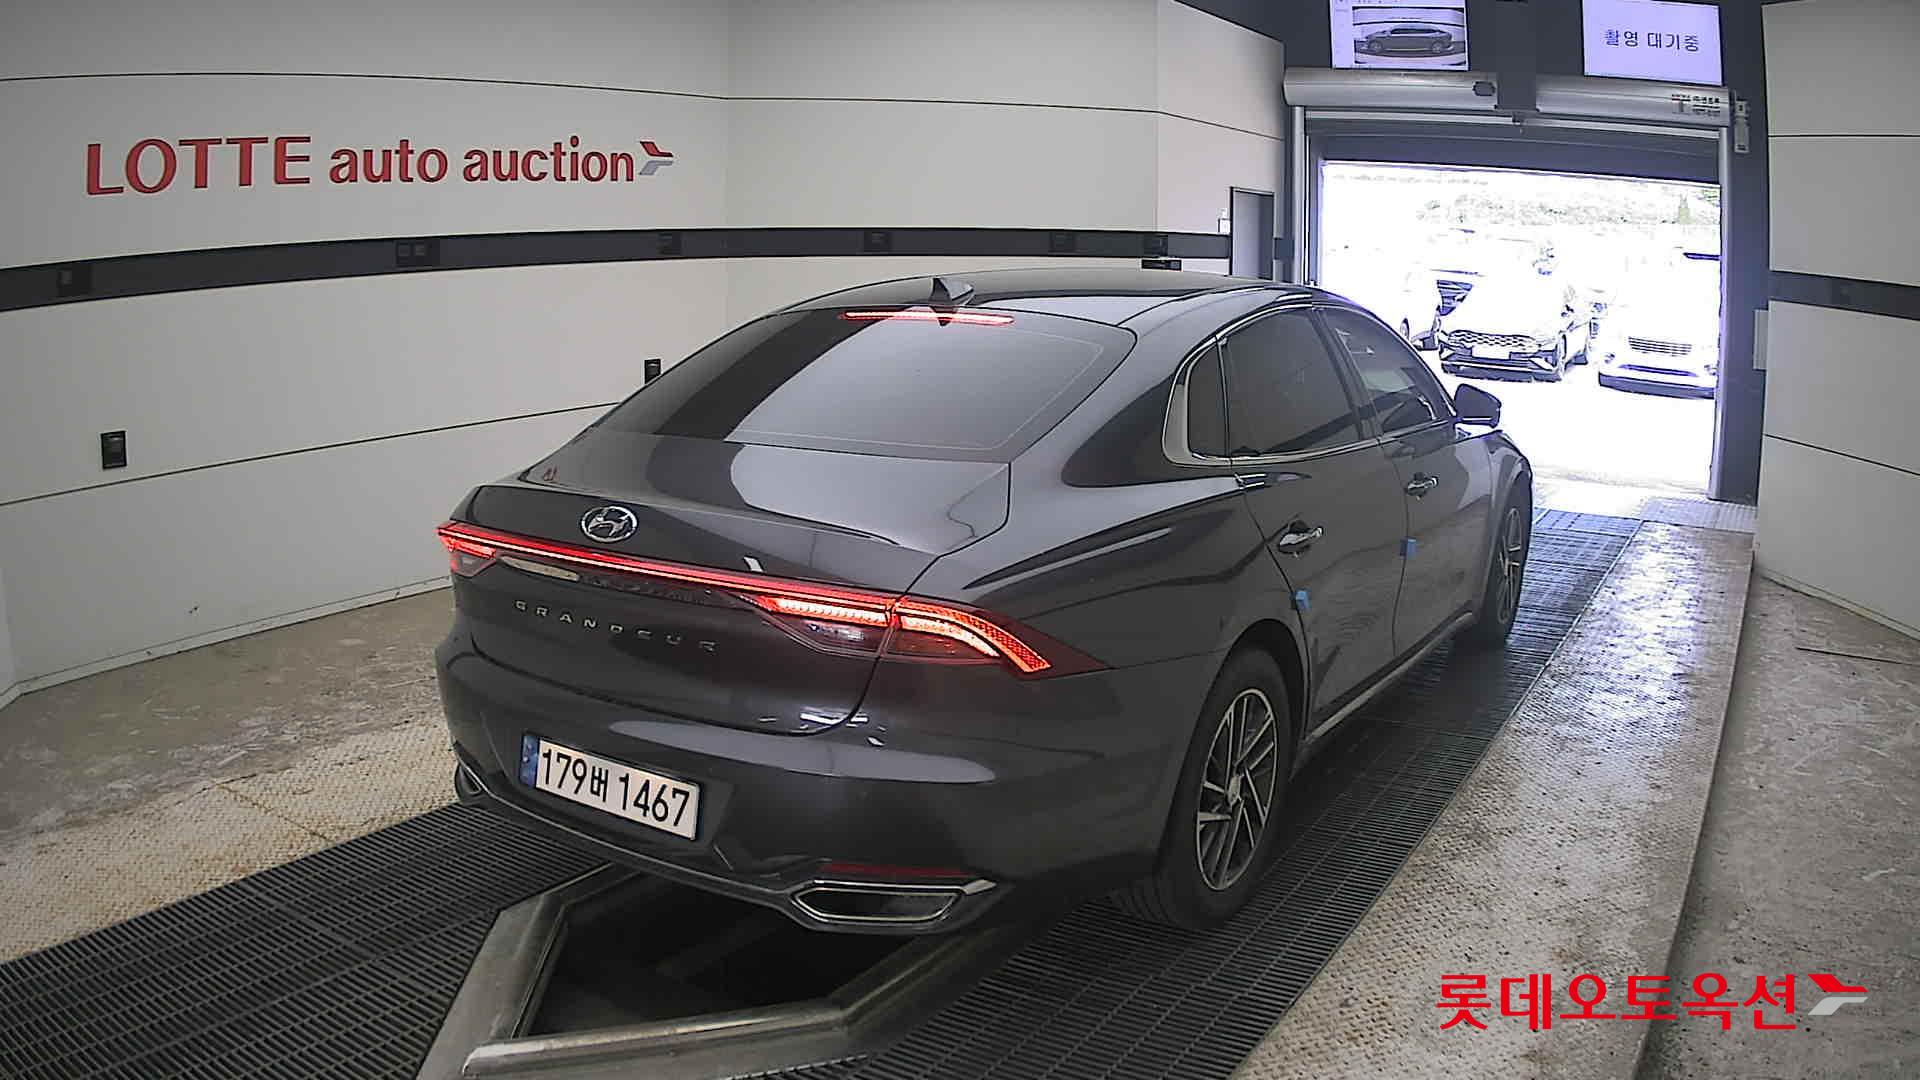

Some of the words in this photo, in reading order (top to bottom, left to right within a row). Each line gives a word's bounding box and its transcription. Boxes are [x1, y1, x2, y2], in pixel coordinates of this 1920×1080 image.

[1605, 29, 1639, 48] 촬영
[1647, 32, 1699, 52] 대기중
[87, 136, 312, 196] LOTTE
[329, 139, 448, 184] auto
[463, 135, 635, 184] auction
[515, 600, 717, 652] GRANDEUR
[543, 748, 609, 803] 179버
[619, 772, 690, 828] 1467
